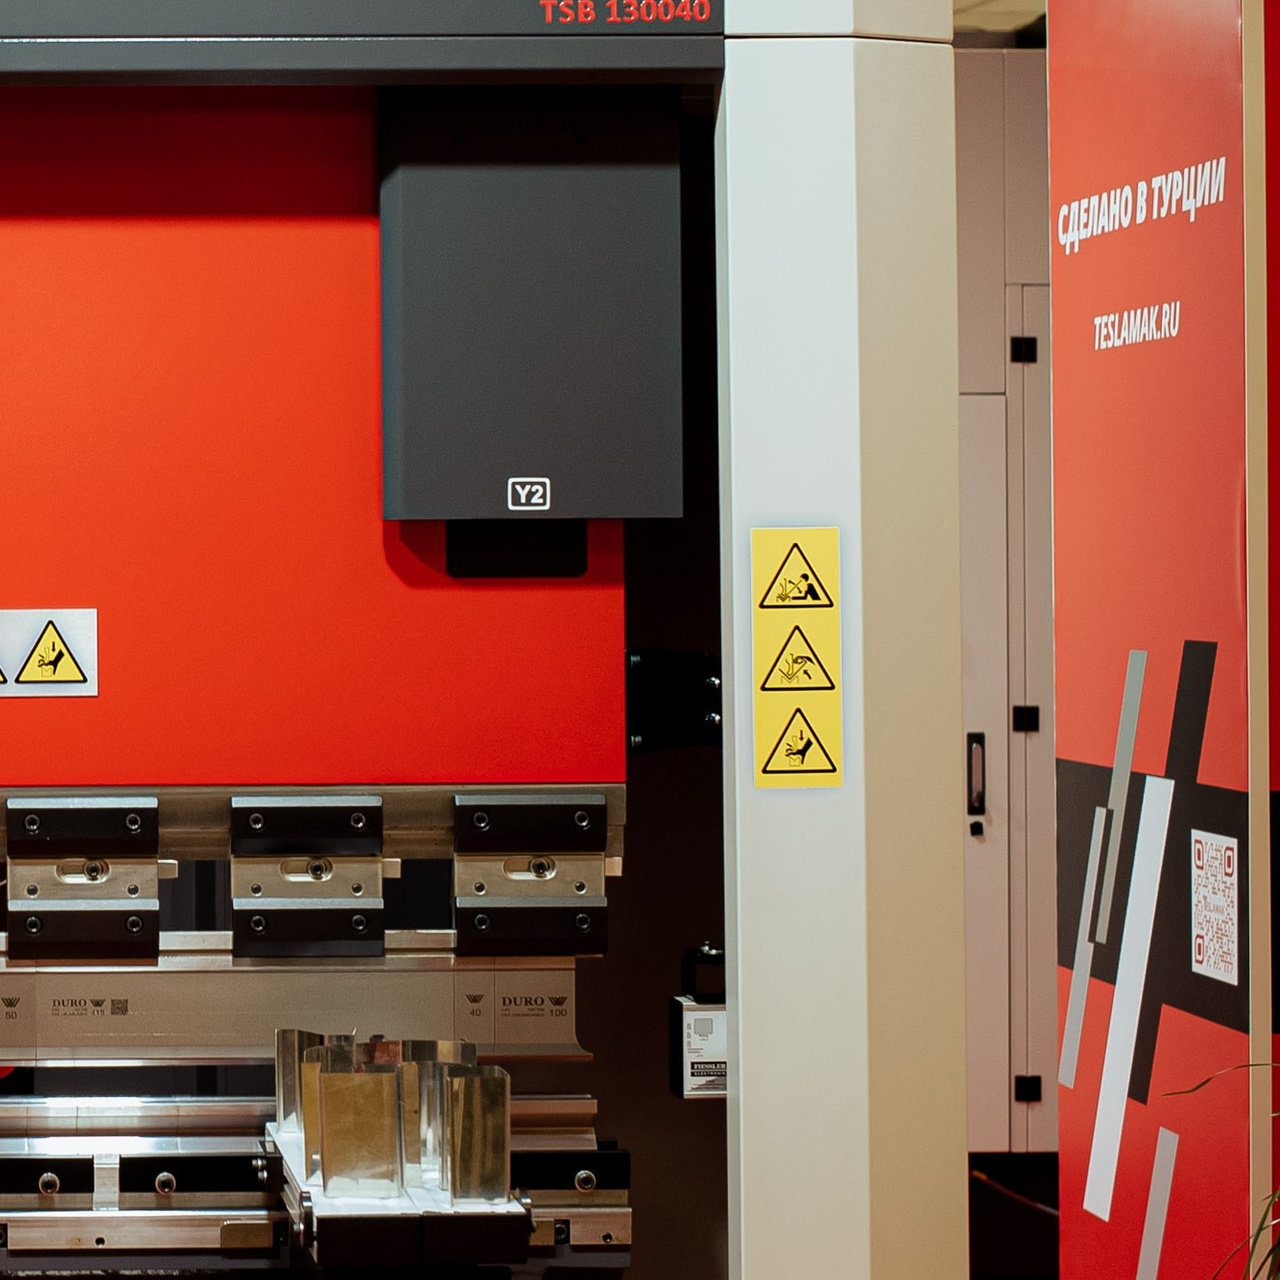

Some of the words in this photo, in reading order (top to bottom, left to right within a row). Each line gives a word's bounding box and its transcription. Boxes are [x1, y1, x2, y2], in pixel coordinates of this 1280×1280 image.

[539, 0, 596, 24] TSB
[1058, 185, 1133, 256] СДЕЛАНО
[1135, 180, 1147, 225] В
[1151, 156, 1226, 223] ТУРЦИИ
[1093, 301, 1180, 351] TESLAMAK.RU
[514, 484, 544, 504] Y2
[52, 998, 88, 1008] DURO
[501, 995, 545, 1007] DURO
[469, 1008, 482, 1017] 40
[548, 1008, 568, 1017] 100
